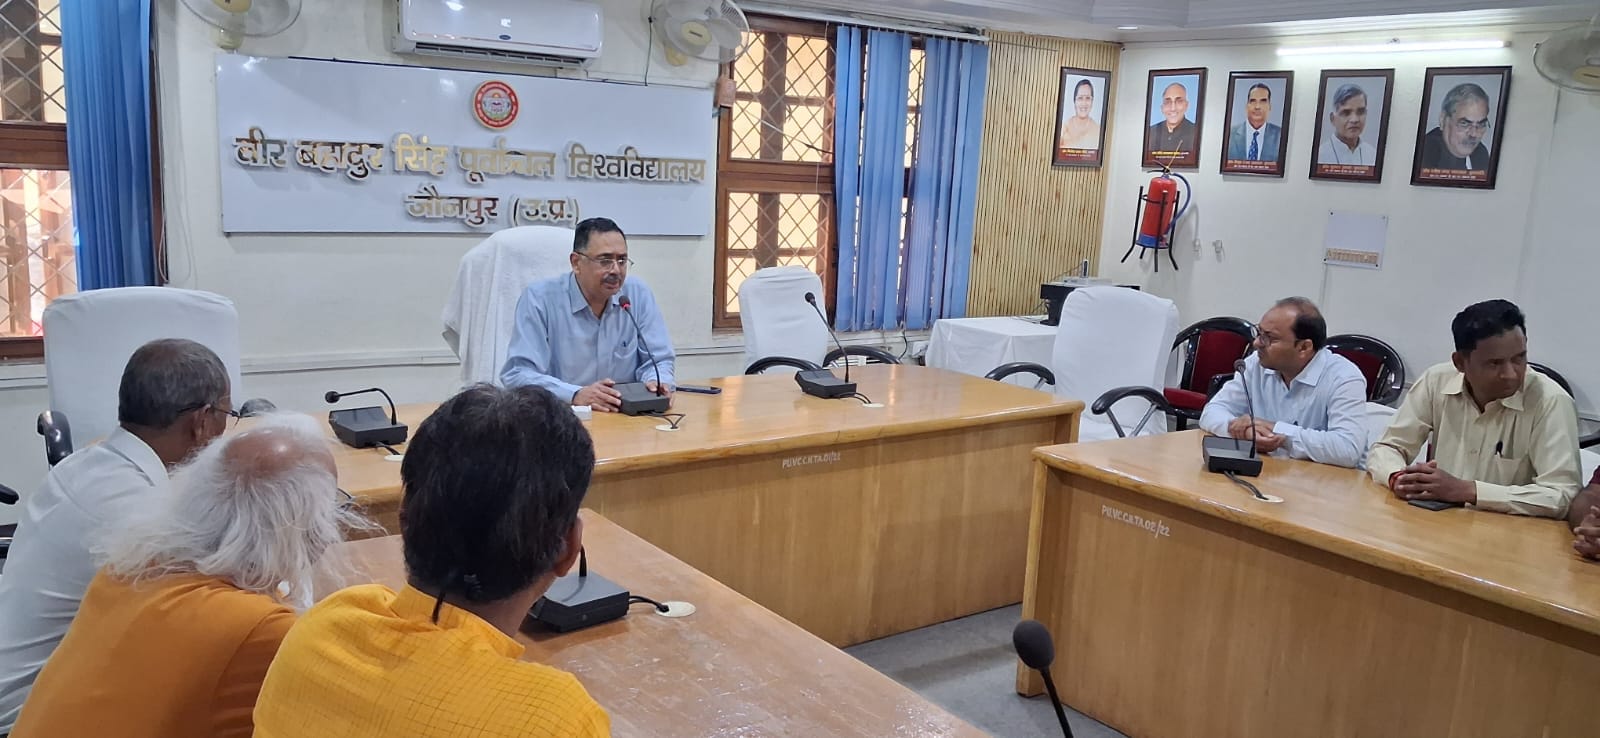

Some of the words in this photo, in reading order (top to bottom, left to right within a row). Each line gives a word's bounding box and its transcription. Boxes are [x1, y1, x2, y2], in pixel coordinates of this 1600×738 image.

[234, 127, 287, 166] वीर
[299, 140, 385, 179] बहादुर
[394, 133, 449, 176] सिंह
[568, 143, 706, 181] विश्वविद्यालय
[407, 185, 500, 226] जौनपुर
